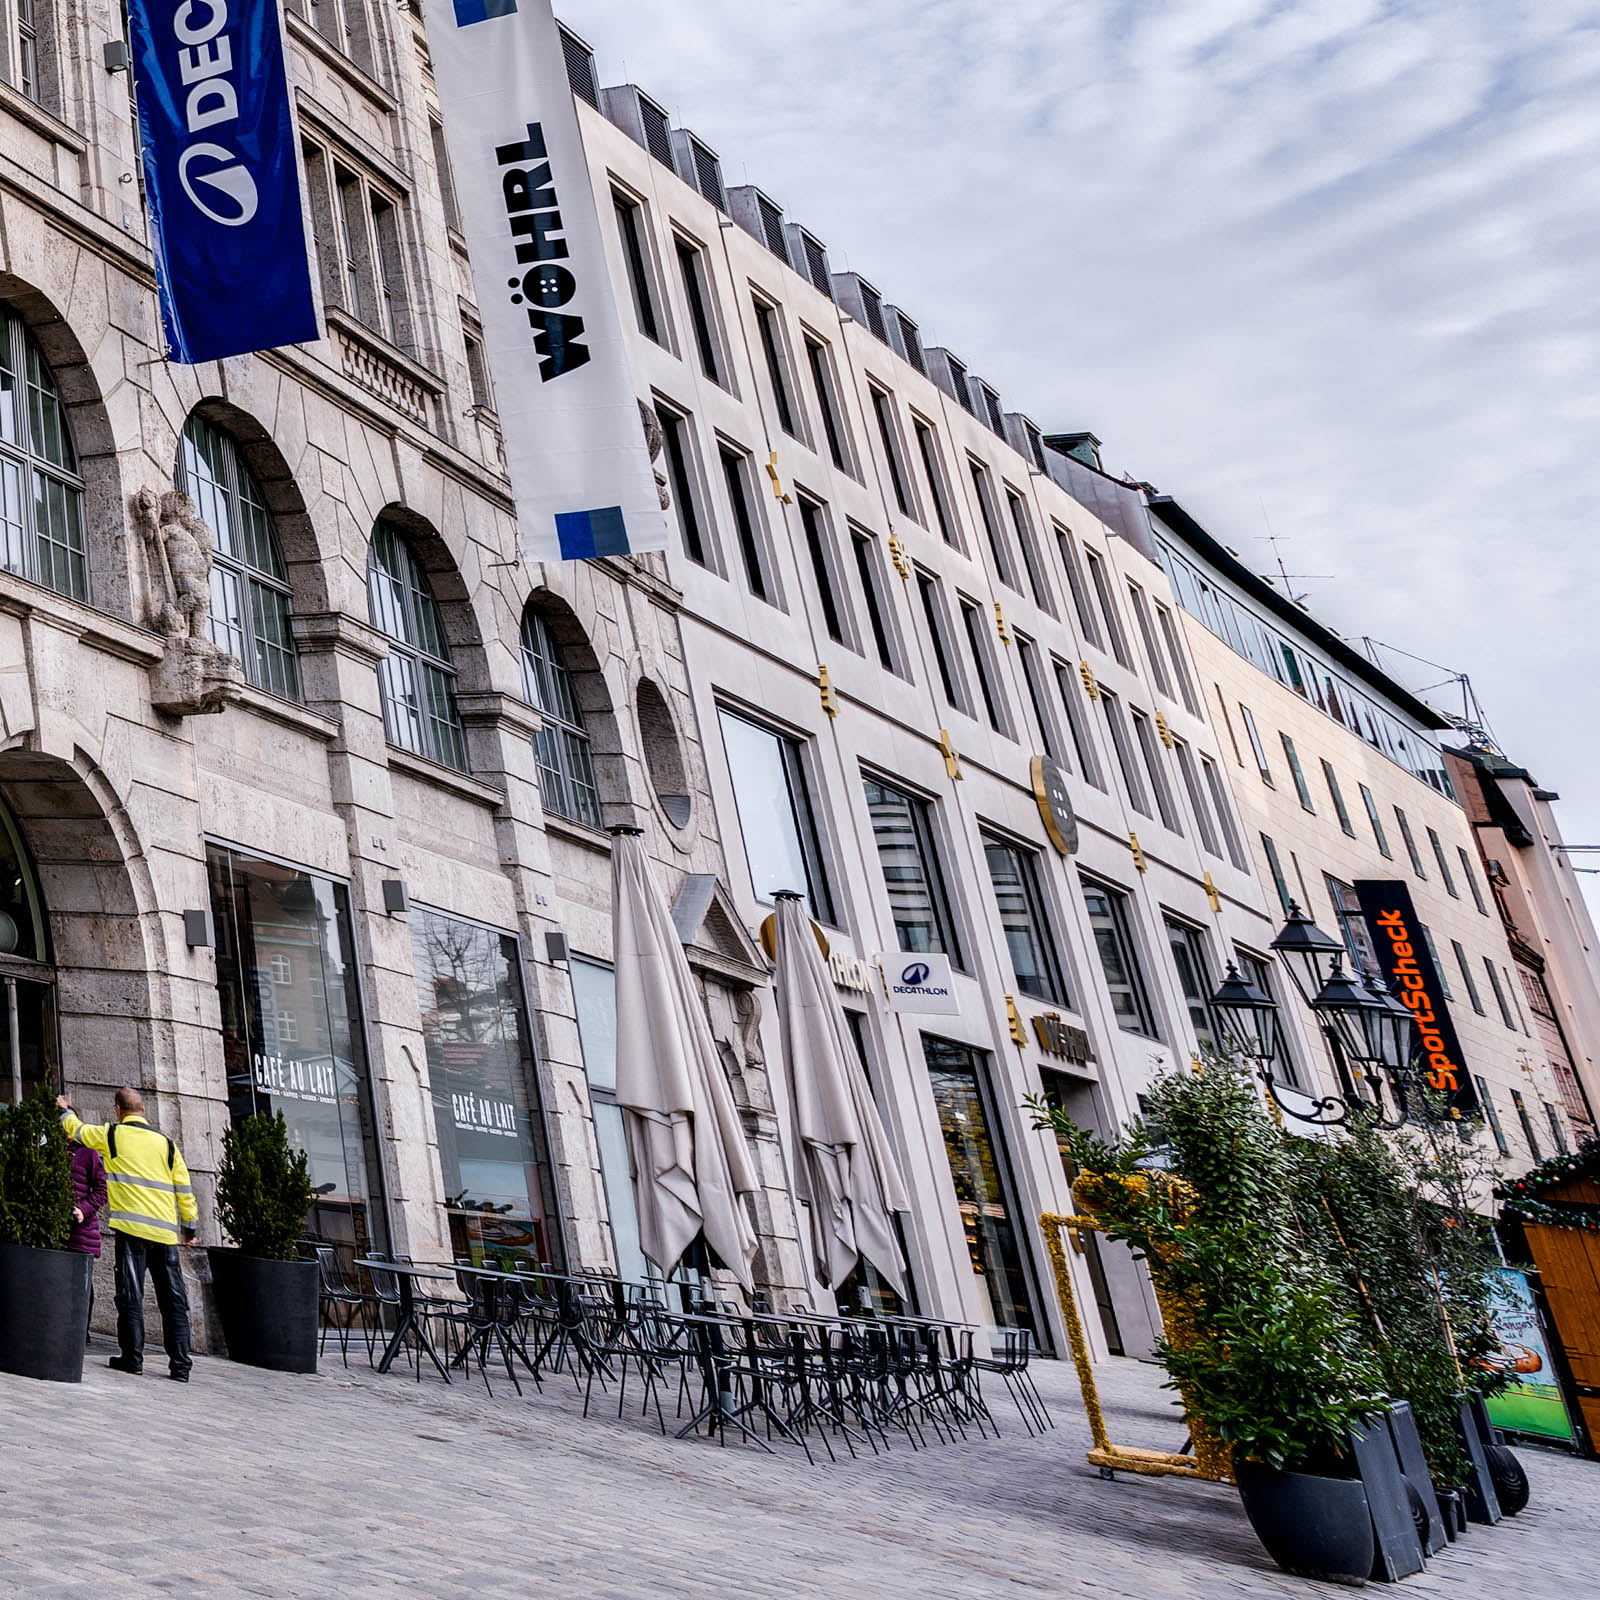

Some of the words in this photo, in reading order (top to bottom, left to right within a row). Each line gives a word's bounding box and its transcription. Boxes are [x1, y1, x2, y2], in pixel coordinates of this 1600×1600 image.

[495, 121, 591, 384] WÖHRL
[827, 952, 875, 993] THLON
[893, 985, 948, 996] DECATHLON
[1376, 909, 1459, 1091] SportScheck
[254, 1052, 285, 1088] CAFÉ
[289, 1060, 305, 1092] AU
[308, 1064, 335, 1097] LAIT
[451, 1091, 478, 1123] CAFÉ
[479, 1099, 493, 1127] AU
[494, 1101, 517, 1131] LAIT
